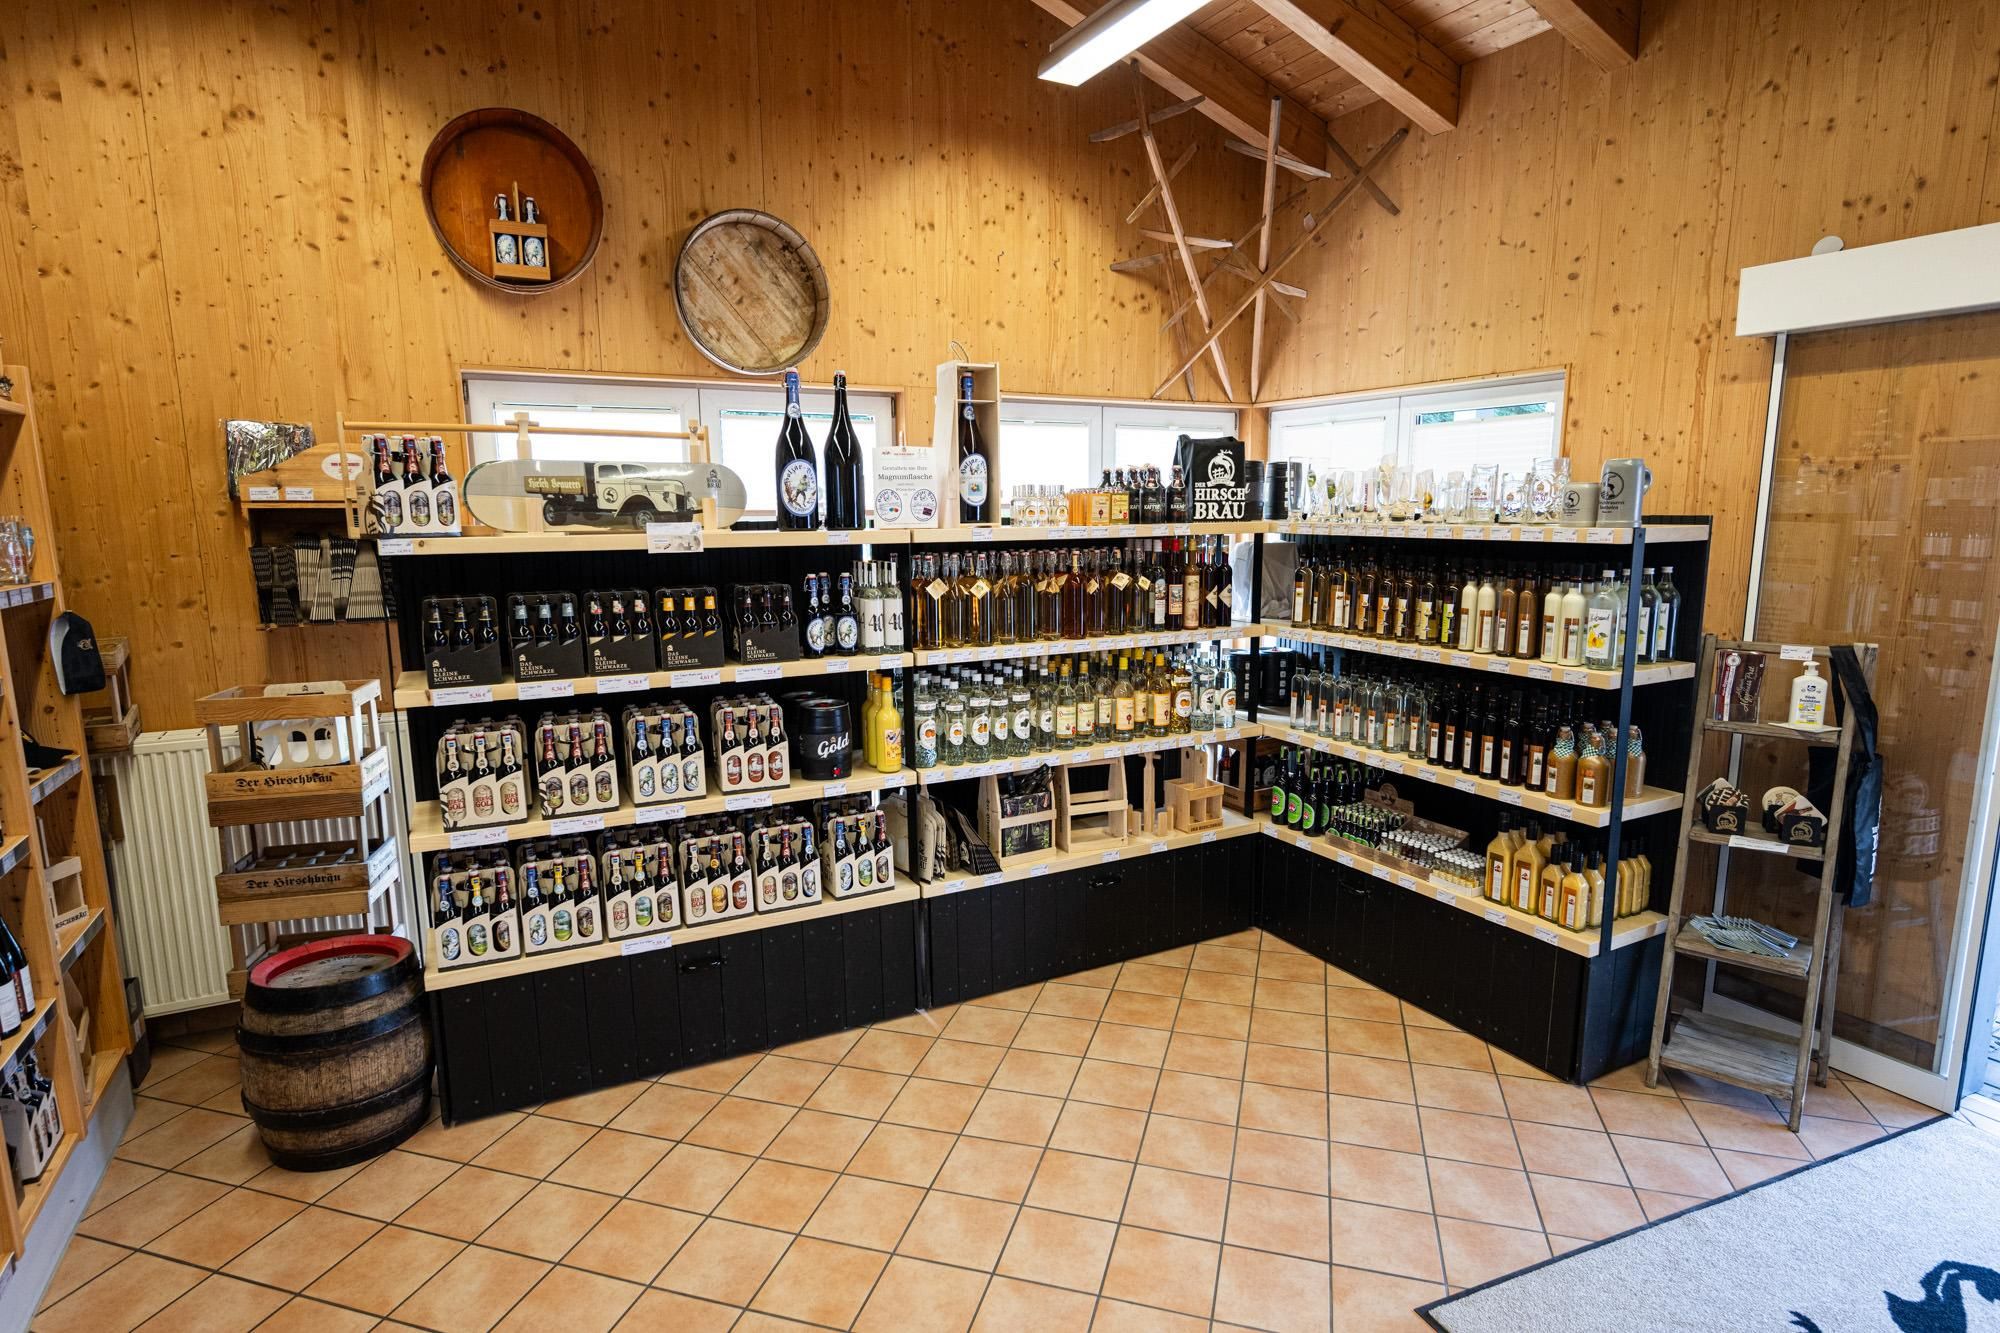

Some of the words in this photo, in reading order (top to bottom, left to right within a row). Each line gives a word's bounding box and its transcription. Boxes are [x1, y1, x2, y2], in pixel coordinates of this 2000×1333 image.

[878, 473, 933, 481] Magnumflasche
[1194, 487, 1246, 501] HIRSCH
[1193, 500, 1246, 519] BRÄU
[817, 732, 850, 759] Gold
[235, 777, 260, 789] Der
[263, 773, 334, 788] Hirschbräu
[245, 878, 269, 890] Der
[272, 873, 341, 888] Hirschbräu
